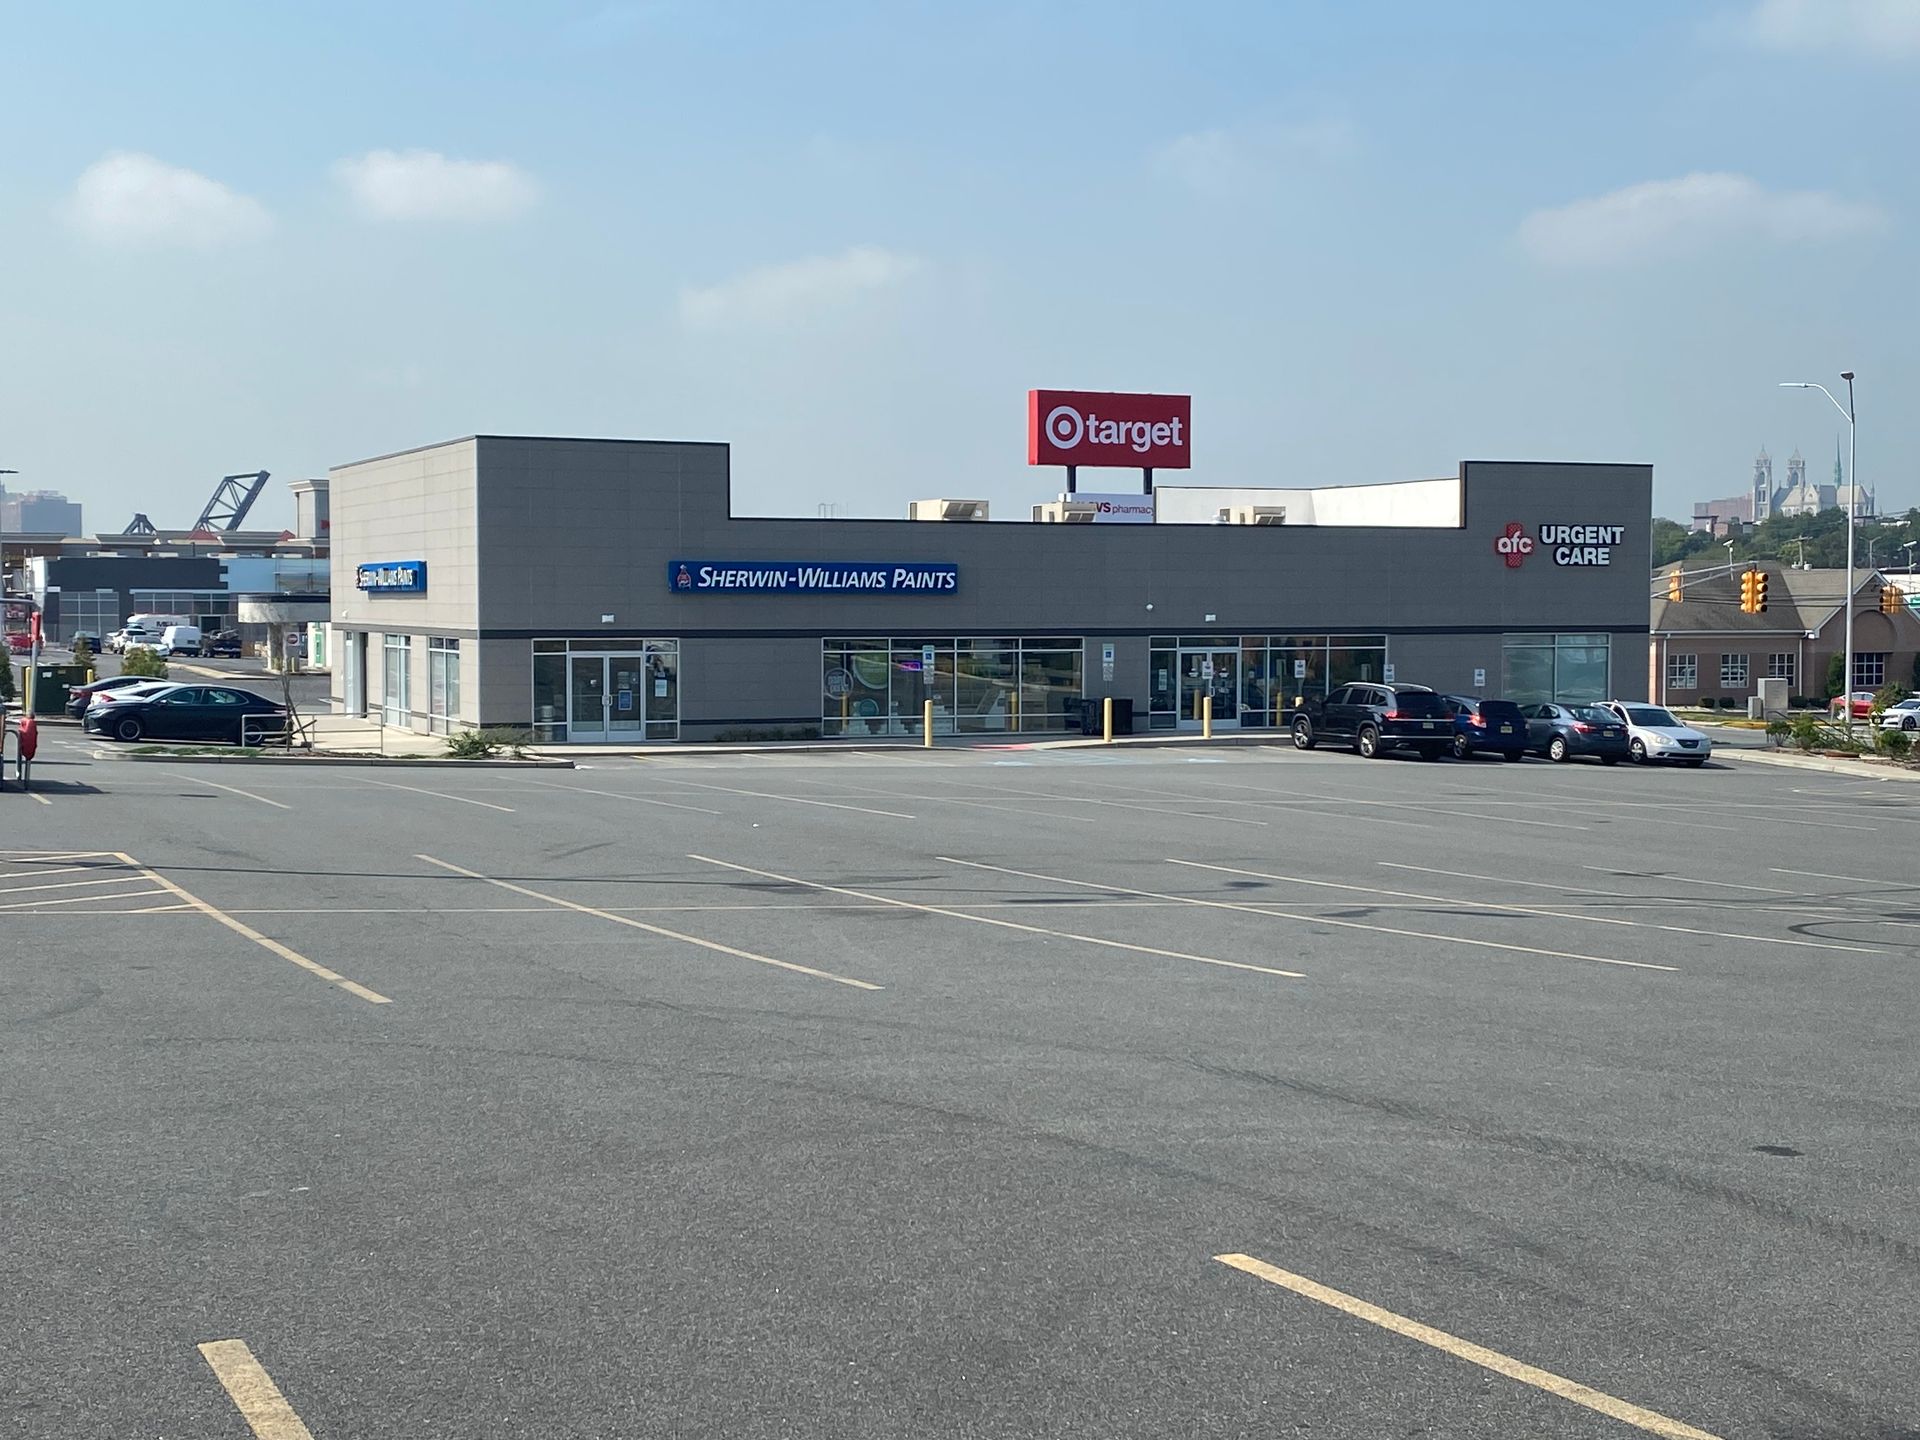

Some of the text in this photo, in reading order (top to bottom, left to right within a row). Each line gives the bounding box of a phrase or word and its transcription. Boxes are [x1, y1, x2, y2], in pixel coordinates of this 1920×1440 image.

[1086, 413, 1183, 453] target
[1498, 530, 1532, 553] afc
[1541, 525, 1625, 544] URGENT
[1555, 546, 1610, 565] CARE
[698, 566, 956, 589] SHERWIN-WILLIAMS PAINTS
